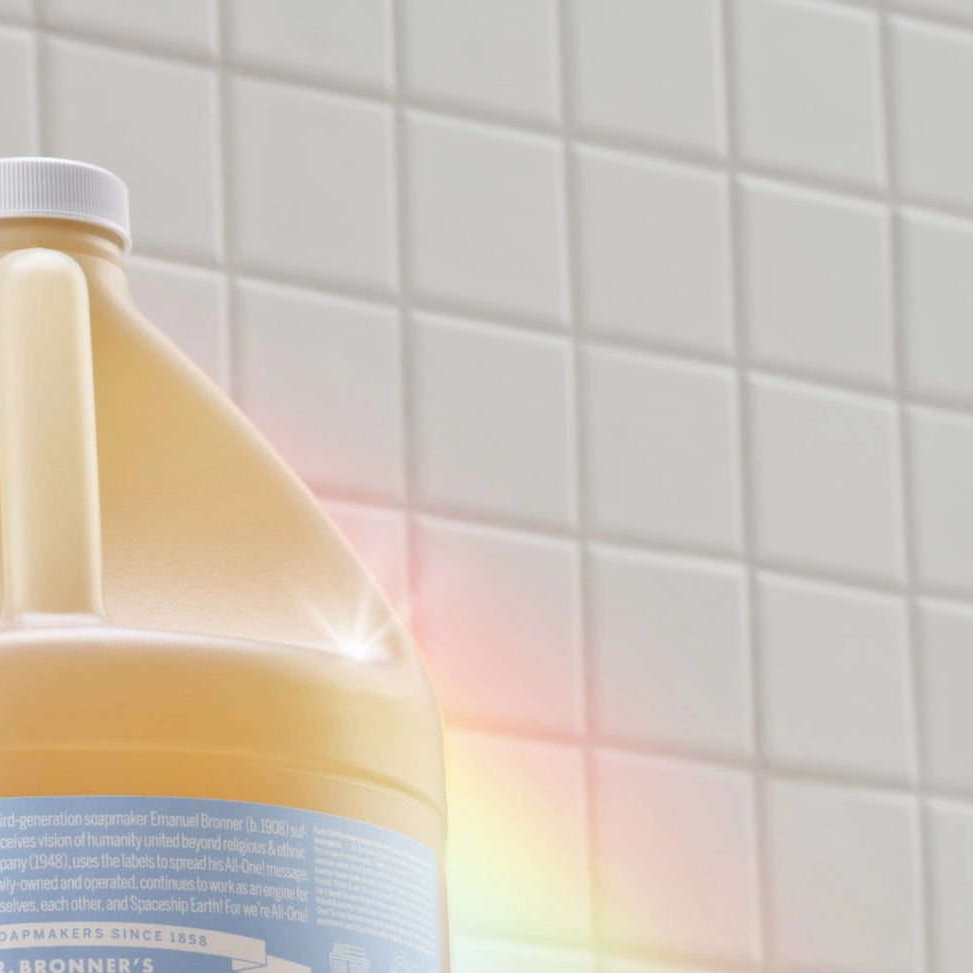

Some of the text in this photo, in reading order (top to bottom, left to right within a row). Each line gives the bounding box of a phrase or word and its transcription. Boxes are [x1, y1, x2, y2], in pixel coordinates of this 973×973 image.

[85, 812, 147, 828] soapmaker
[150, 811, 199, 827] Emanuel
[202, 813, 243, 830] Bronner
[260, 817, 289, 836] 1908)
[39, 833, 72, 848] vision
[76, 833, 88, 847] of
[88, 833, 142, 850] humanity
[144, 833, 179, 848] united
[182, 835, 222, 851] beyond
[223, 838, 266, 855] religious
[276, 843, 306, 860] ethnic
[73, 856, 99, 869] uses
[101, 853, 120, 868] the
[122, 854, 154, 869] labels
[157, 856, 167, 869] to
[171, 856, 206, 872] spread
[208, 857, 224, 871] his
[226, 858, 265, 874] All-One!
[61, 874, 81, 890] and
[141, 876, 195, 892] continues
[197, 878, 207, 892] to
[209, 879, 235, 893] work
[236, 882, 247, 894] as
[250, 883, 261, 894] an
[263, 885, 296, 901] engine
[297, 888, 308, 901] for
[40, 896, 68, 912] each
[70, 896, 105, 912] other,
[106, 897, 128, 911] and
[130, 896, 187, 915] Spaceship
[191, 898, 223, 913] Earth!
[225, 900, 240, 915] For
[111, 927, 162, 942] SINCE
[170, 932, 207, 947] 1858
